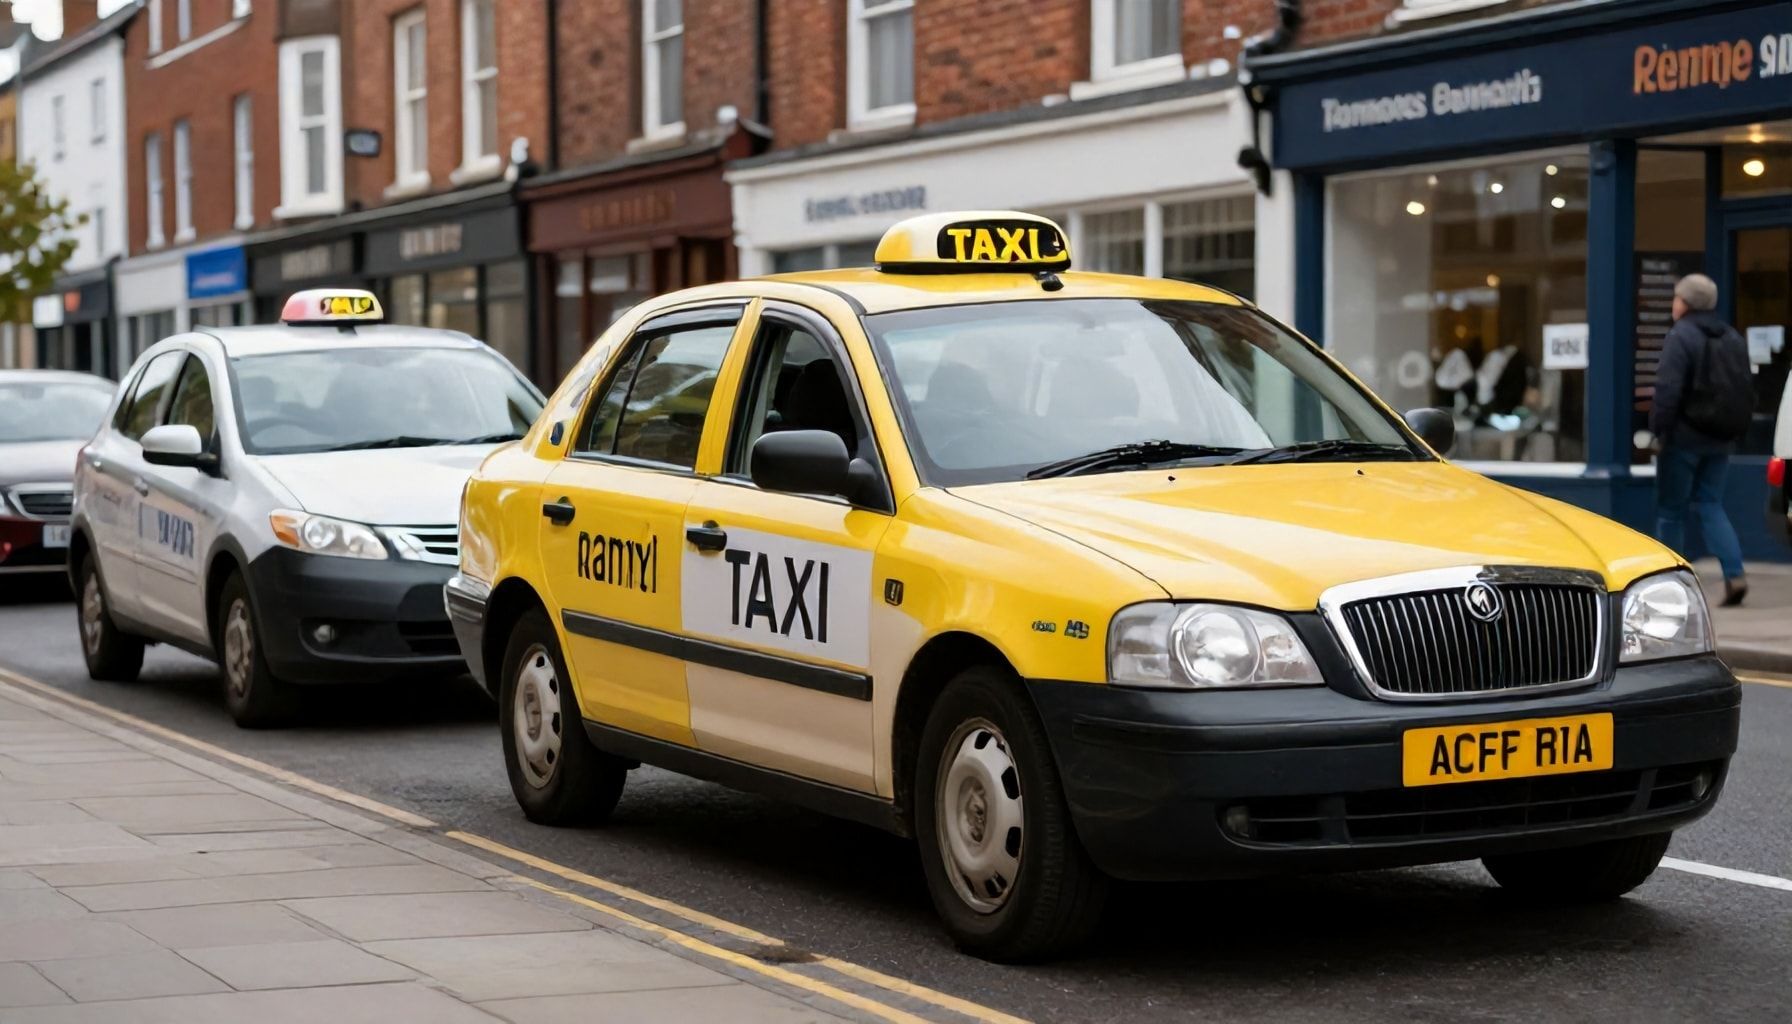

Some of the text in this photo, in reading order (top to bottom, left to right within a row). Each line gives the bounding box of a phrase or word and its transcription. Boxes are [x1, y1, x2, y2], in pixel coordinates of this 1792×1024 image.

[947, 227, 1041, 263] TAXI
[725, 548, 829, 643] TAXI
[1429, 730, 1521, 776] ACFF
